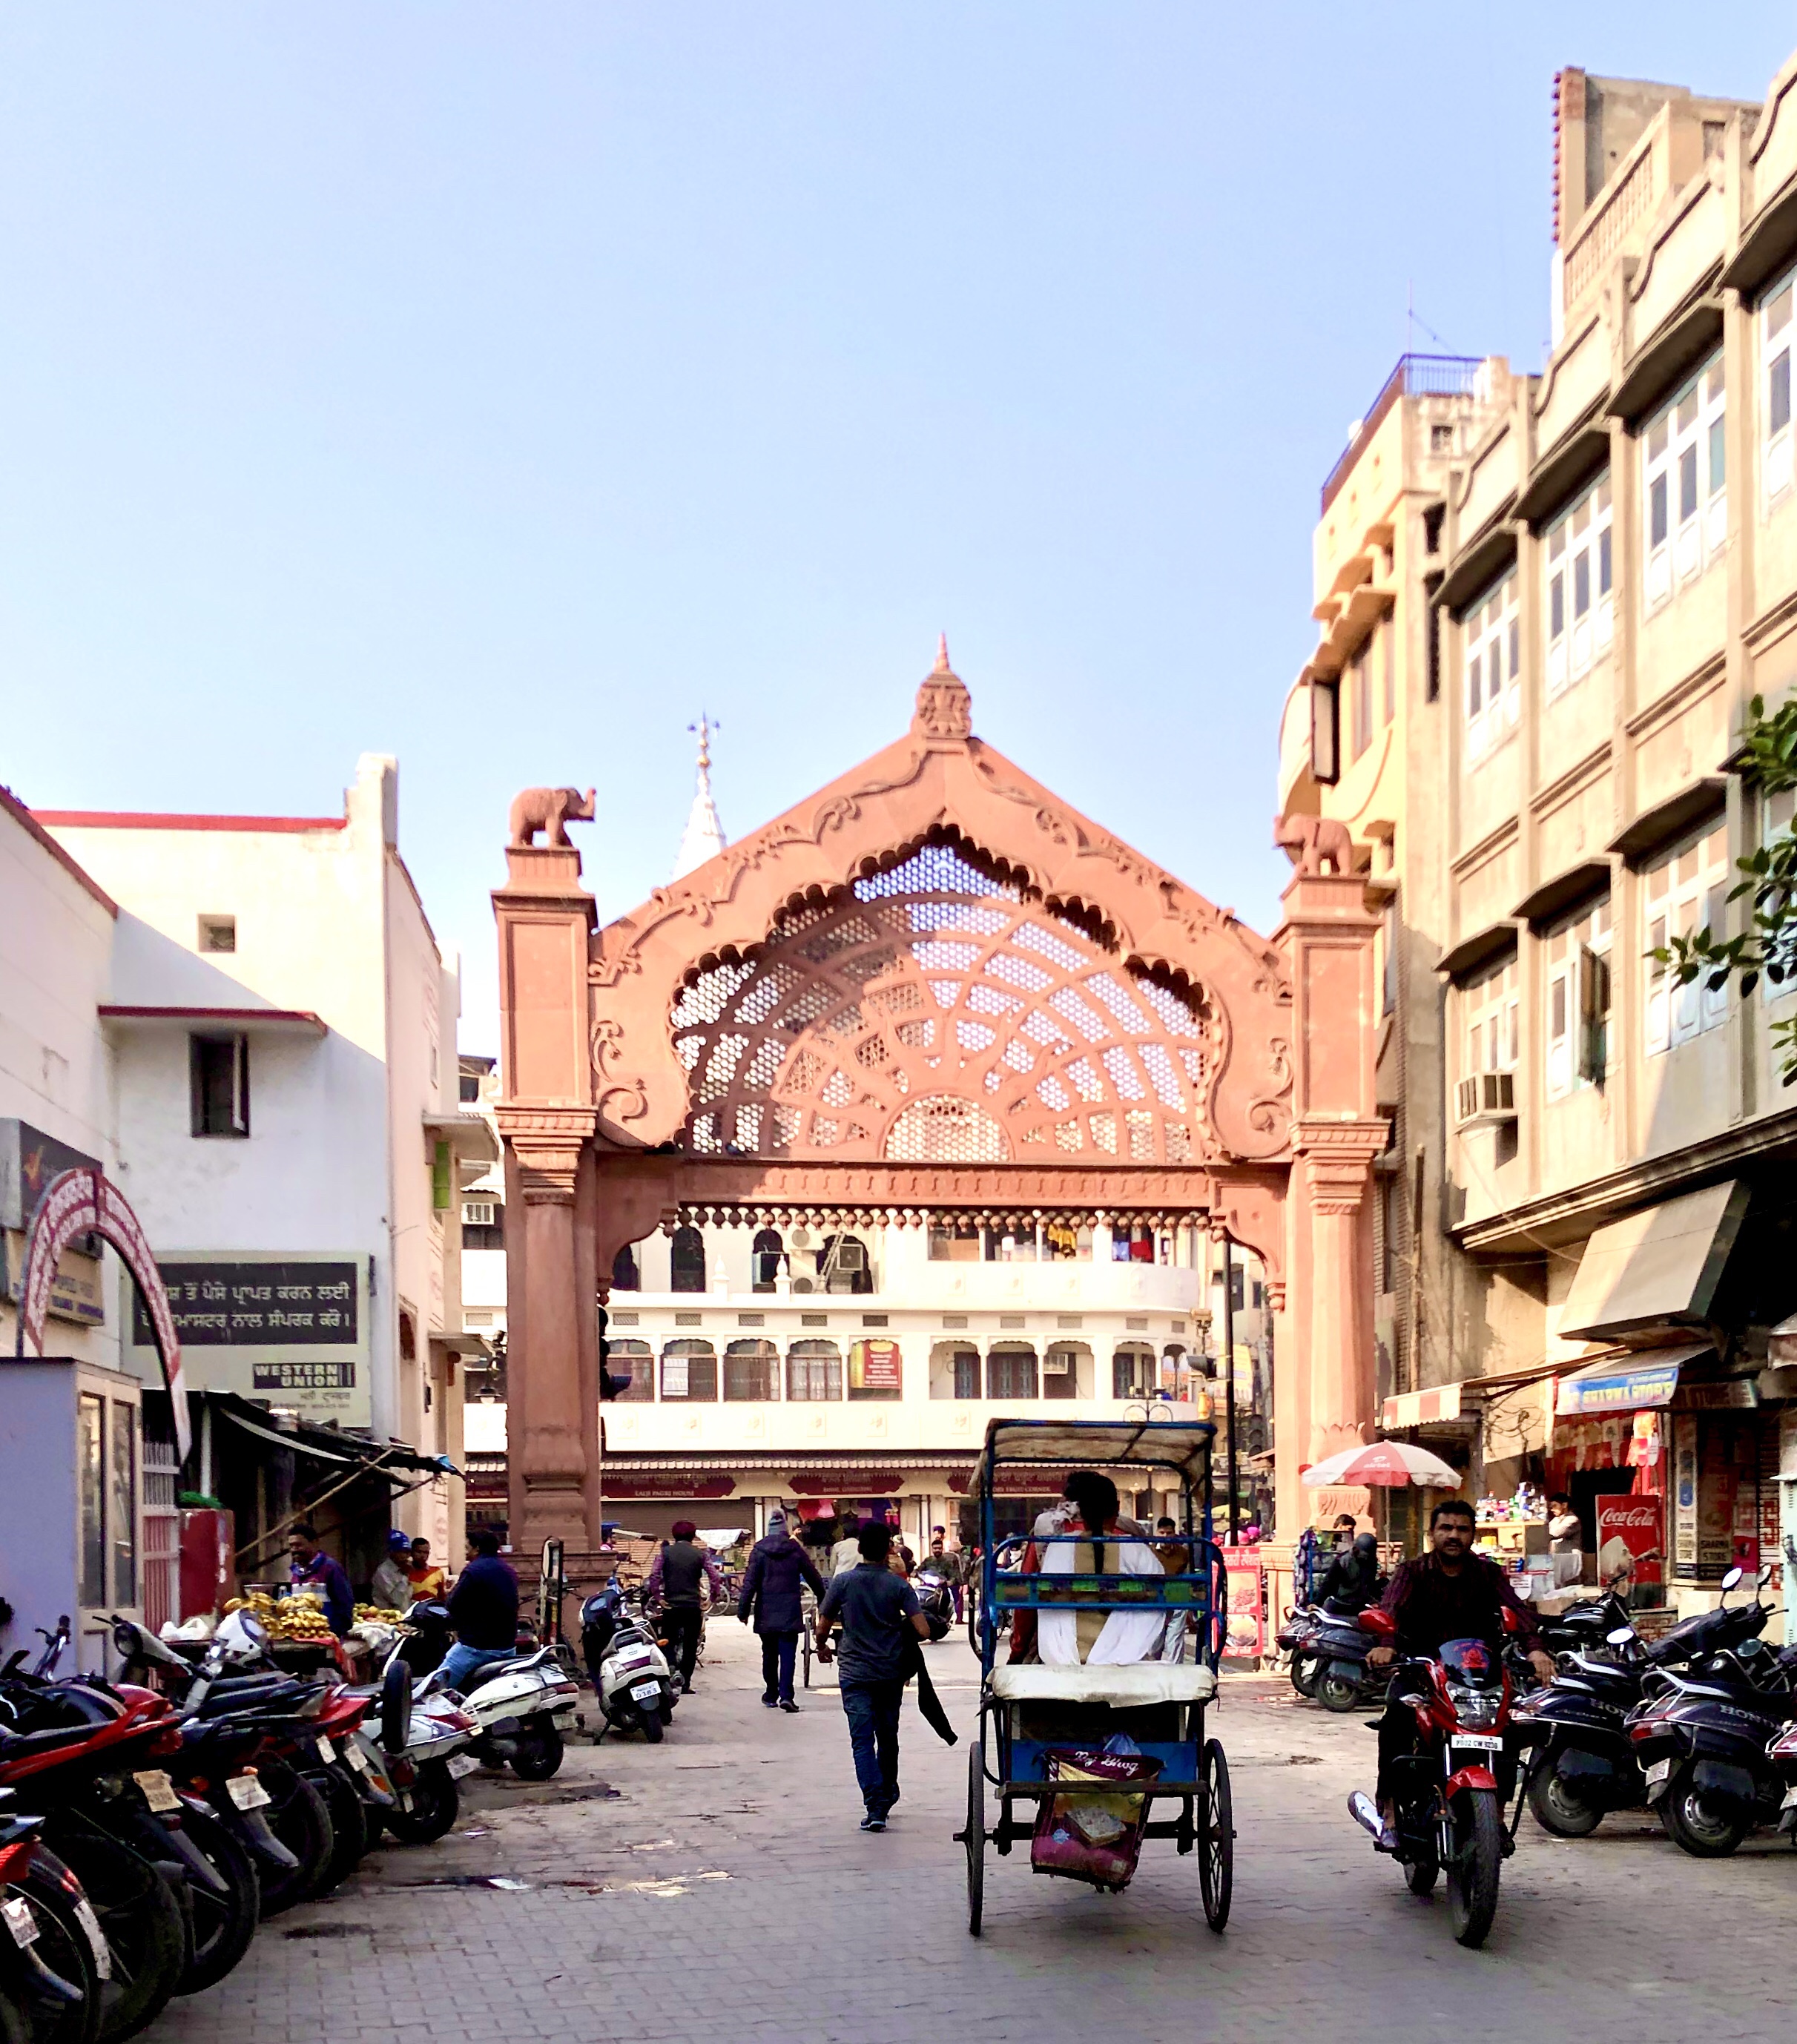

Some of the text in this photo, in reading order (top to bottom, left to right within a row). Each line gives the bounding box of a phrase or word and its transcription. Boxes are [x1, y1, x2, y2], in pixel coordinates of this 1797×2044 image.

[277, 1286, 312, 1299] ਕਰਨ
[317, 1282, 349, 1299] ਲਈ
[231, 1313, 263, 1328] ਨਾਲ
[255, 1364, 337, 1376] WESTERN
[280, 1375, 337, 1386] UNION
